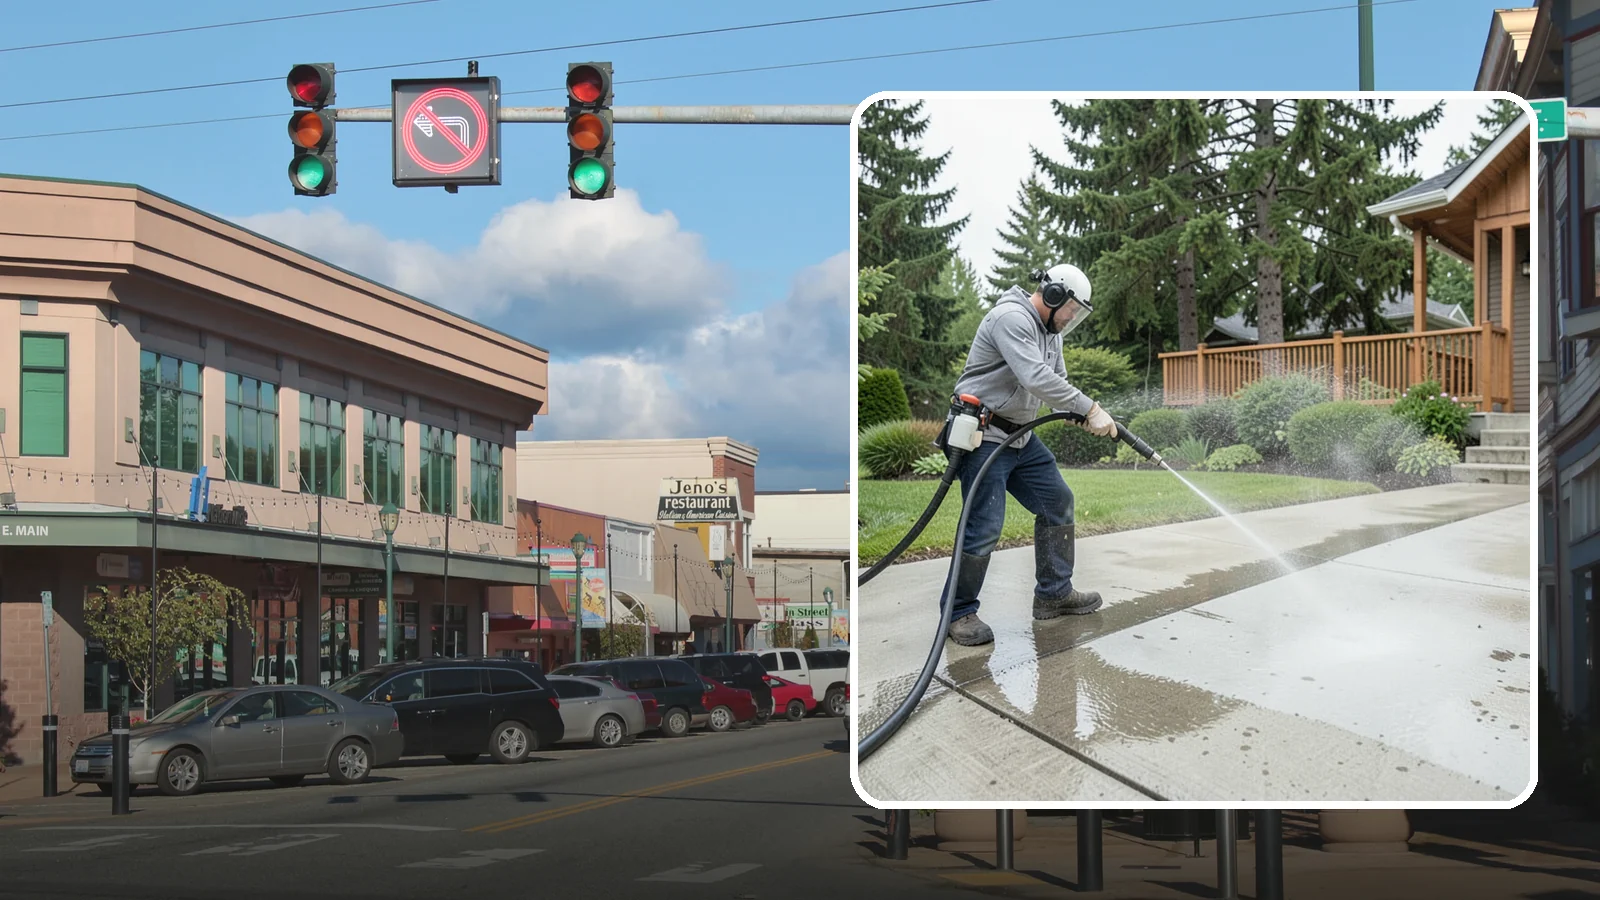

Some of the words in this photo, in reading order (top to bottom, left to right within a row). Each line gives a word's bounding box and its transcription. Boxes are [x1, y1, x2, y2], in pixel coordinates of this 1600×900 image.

[669, 480, 728, 495] Jeno's
[665, 496, 731, 509] restaurant
[658, 510, 681, 519] Italian
[686, 510, 714, 519] American
[715, 510, 737, 519] Cuisine
[2, 525, 13, 536] E.
[15, 525, 49, 536] MAIN
[797, 607, 828, 616] Street
[791, 619, 823, 627] lass
